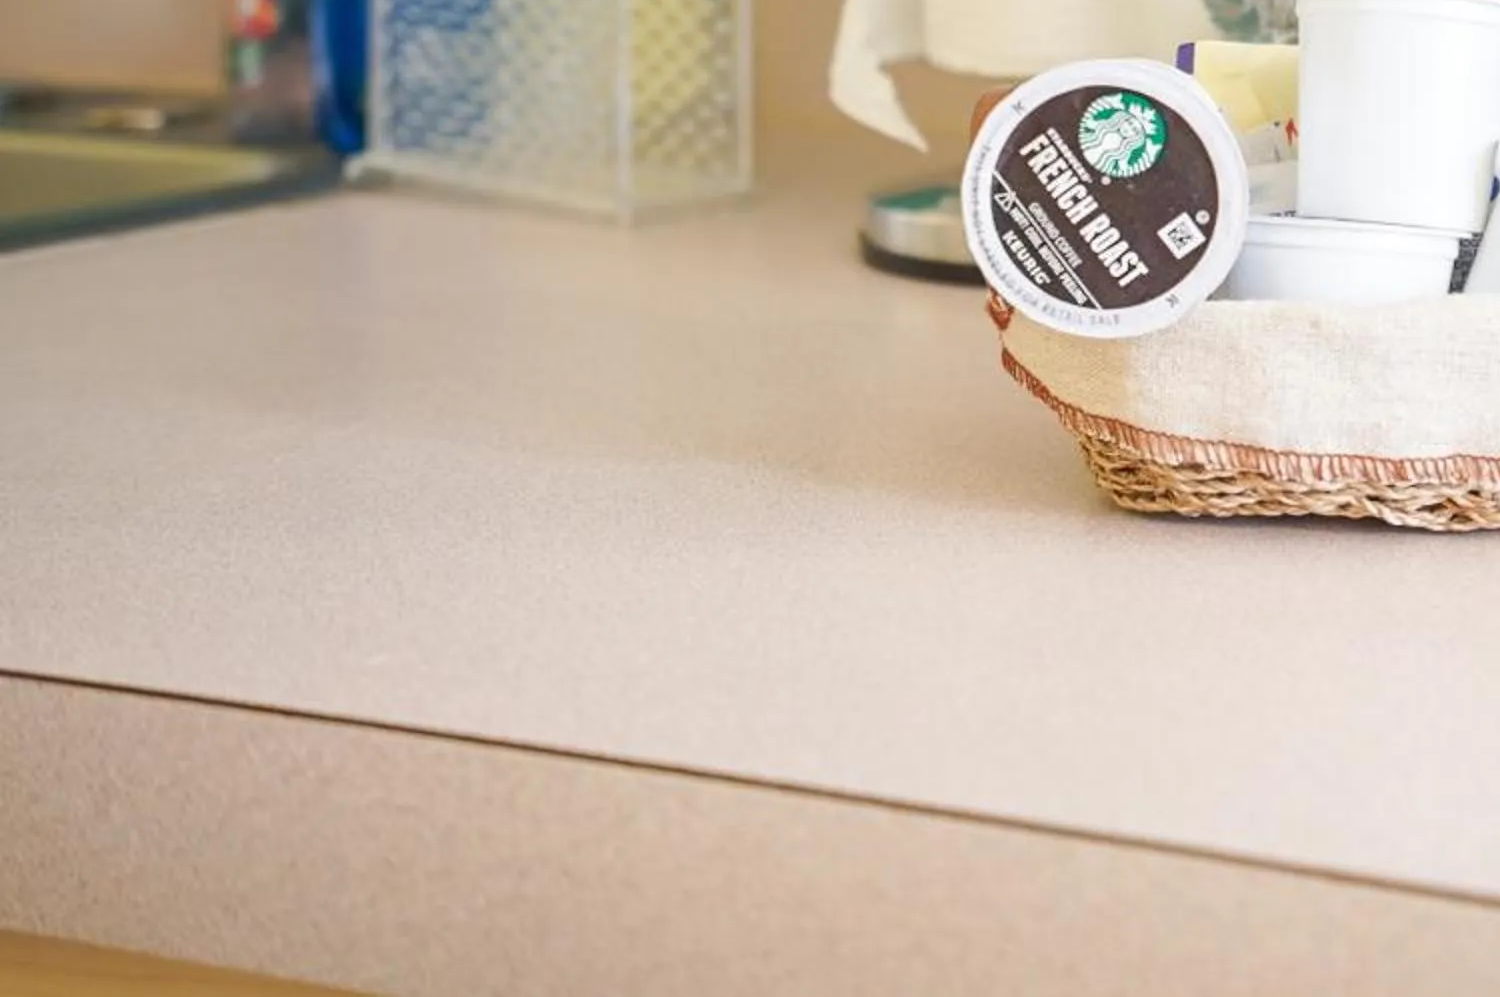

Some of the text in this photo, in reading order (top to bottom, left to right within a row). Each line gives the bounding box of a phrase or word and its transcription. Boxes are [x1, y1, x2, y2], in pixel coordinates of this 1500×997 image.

[1019, 134, 1149, 287] FRENCH ROAST
[1028, 202, 1083, 268] GROUND COFFEE
[1002, 230, 1051, 283] KEURIG
